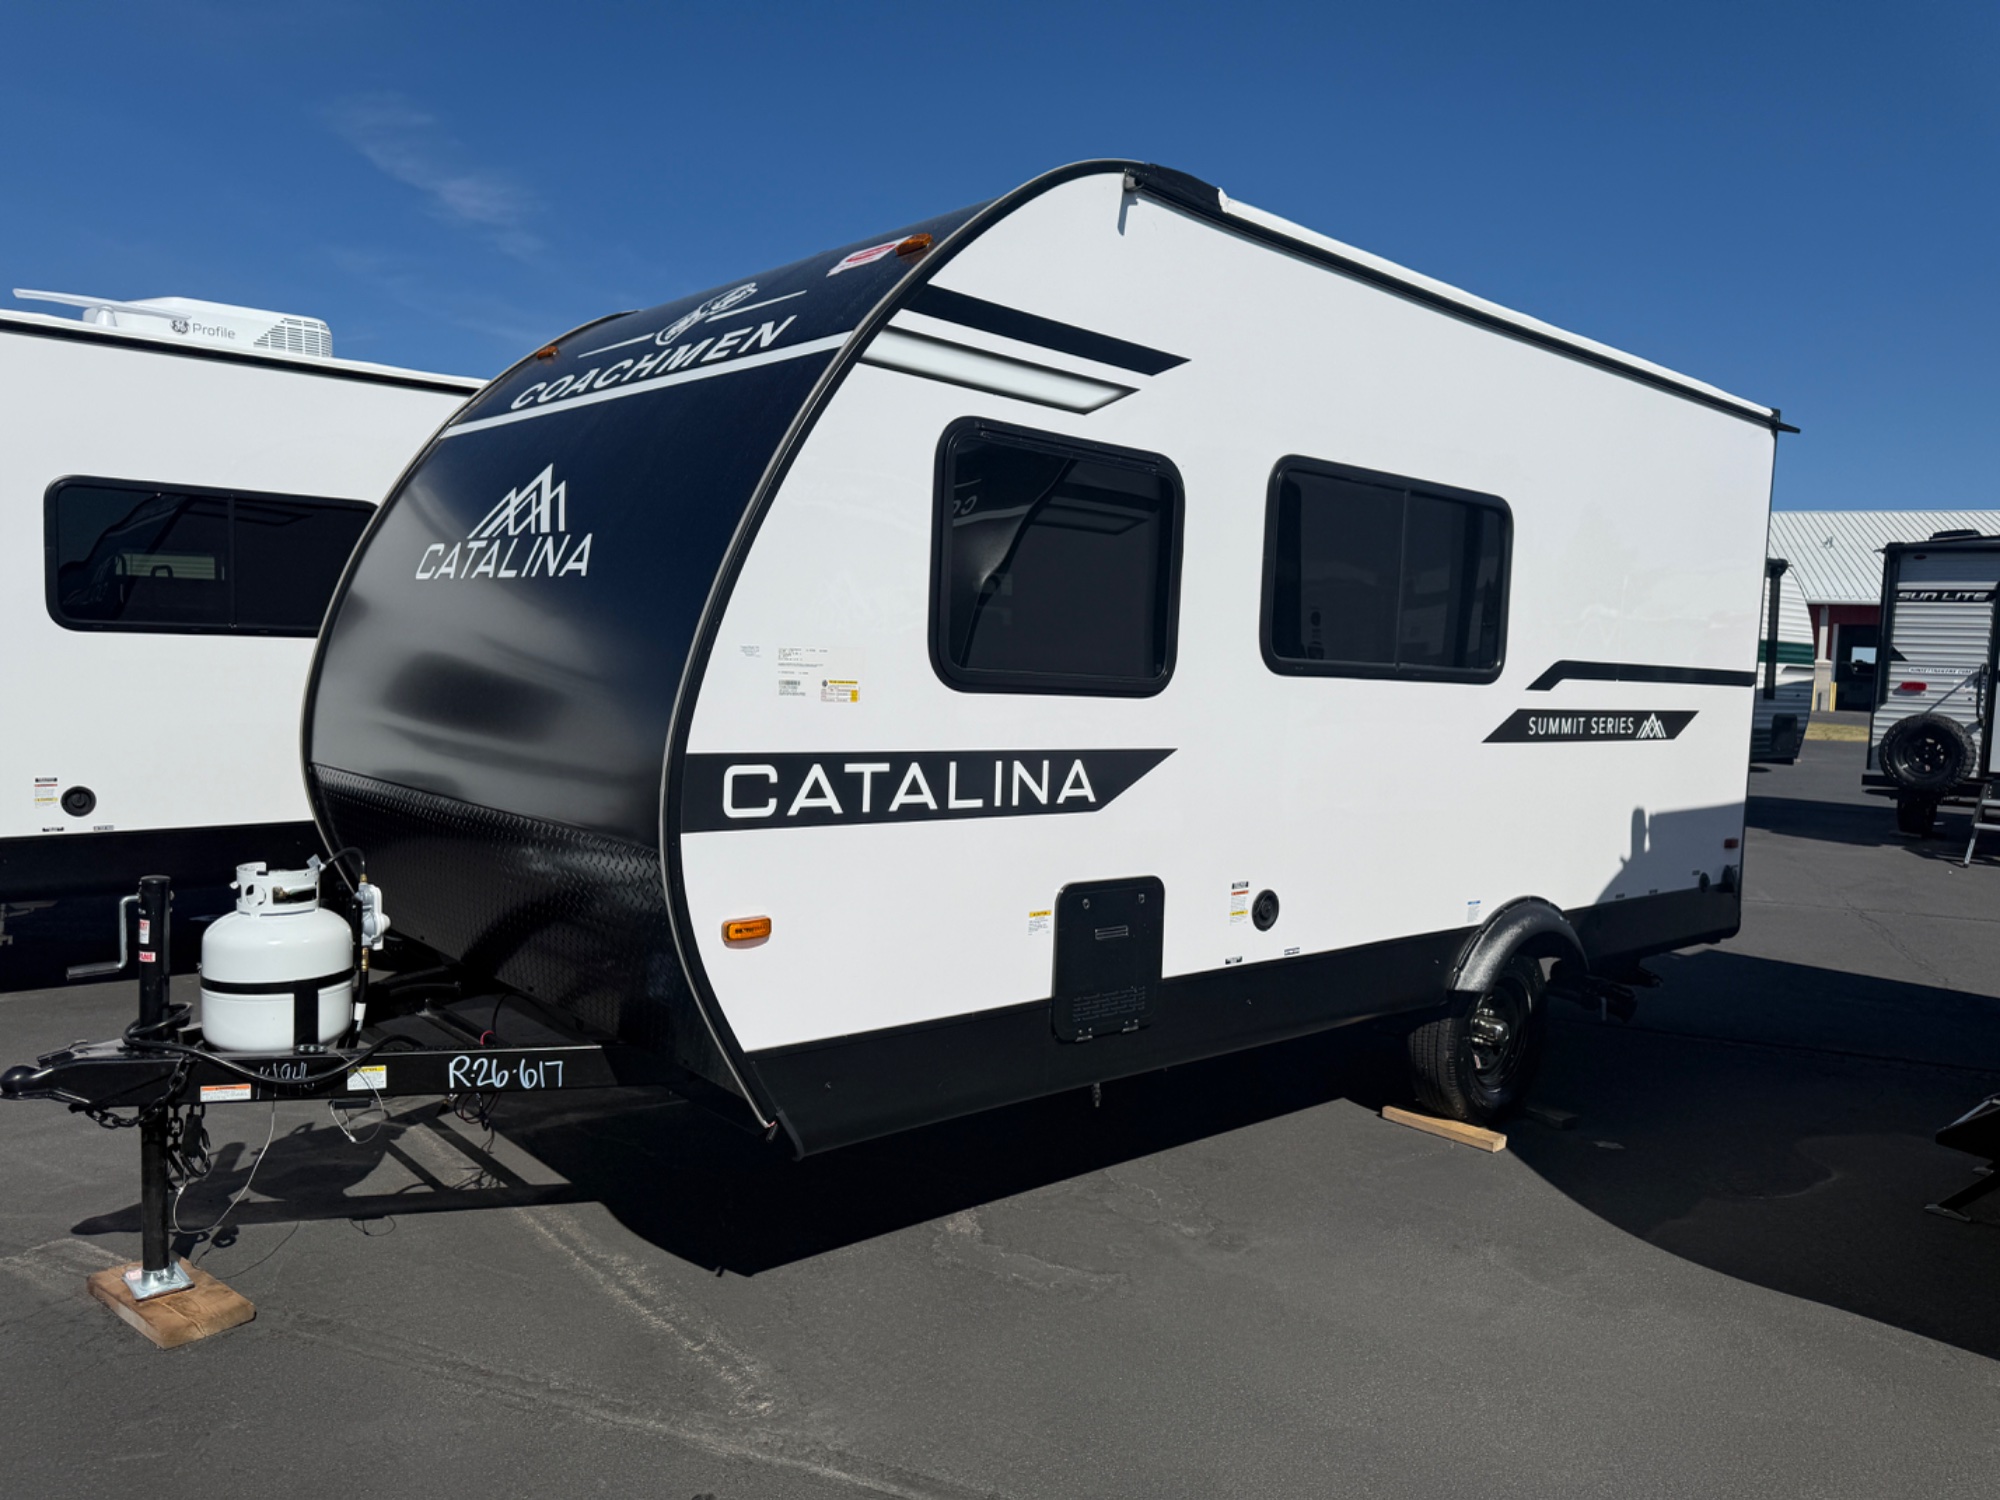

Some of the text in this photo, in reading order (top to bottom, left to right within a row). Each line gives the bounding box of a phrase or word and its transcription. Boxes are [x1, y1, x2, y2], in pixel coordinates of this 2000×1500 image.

[192, 322, 236, 340] Profile
[510, 314, 798, 410] COACHMEN
[415, 532, 593, 580] CATALINA
[1898, 591, 1989, 600] SUN LITE
[1528, 716, 1635, 735] SUMMIT SERIES
[722, 758, 1097, 819] CATALINA
